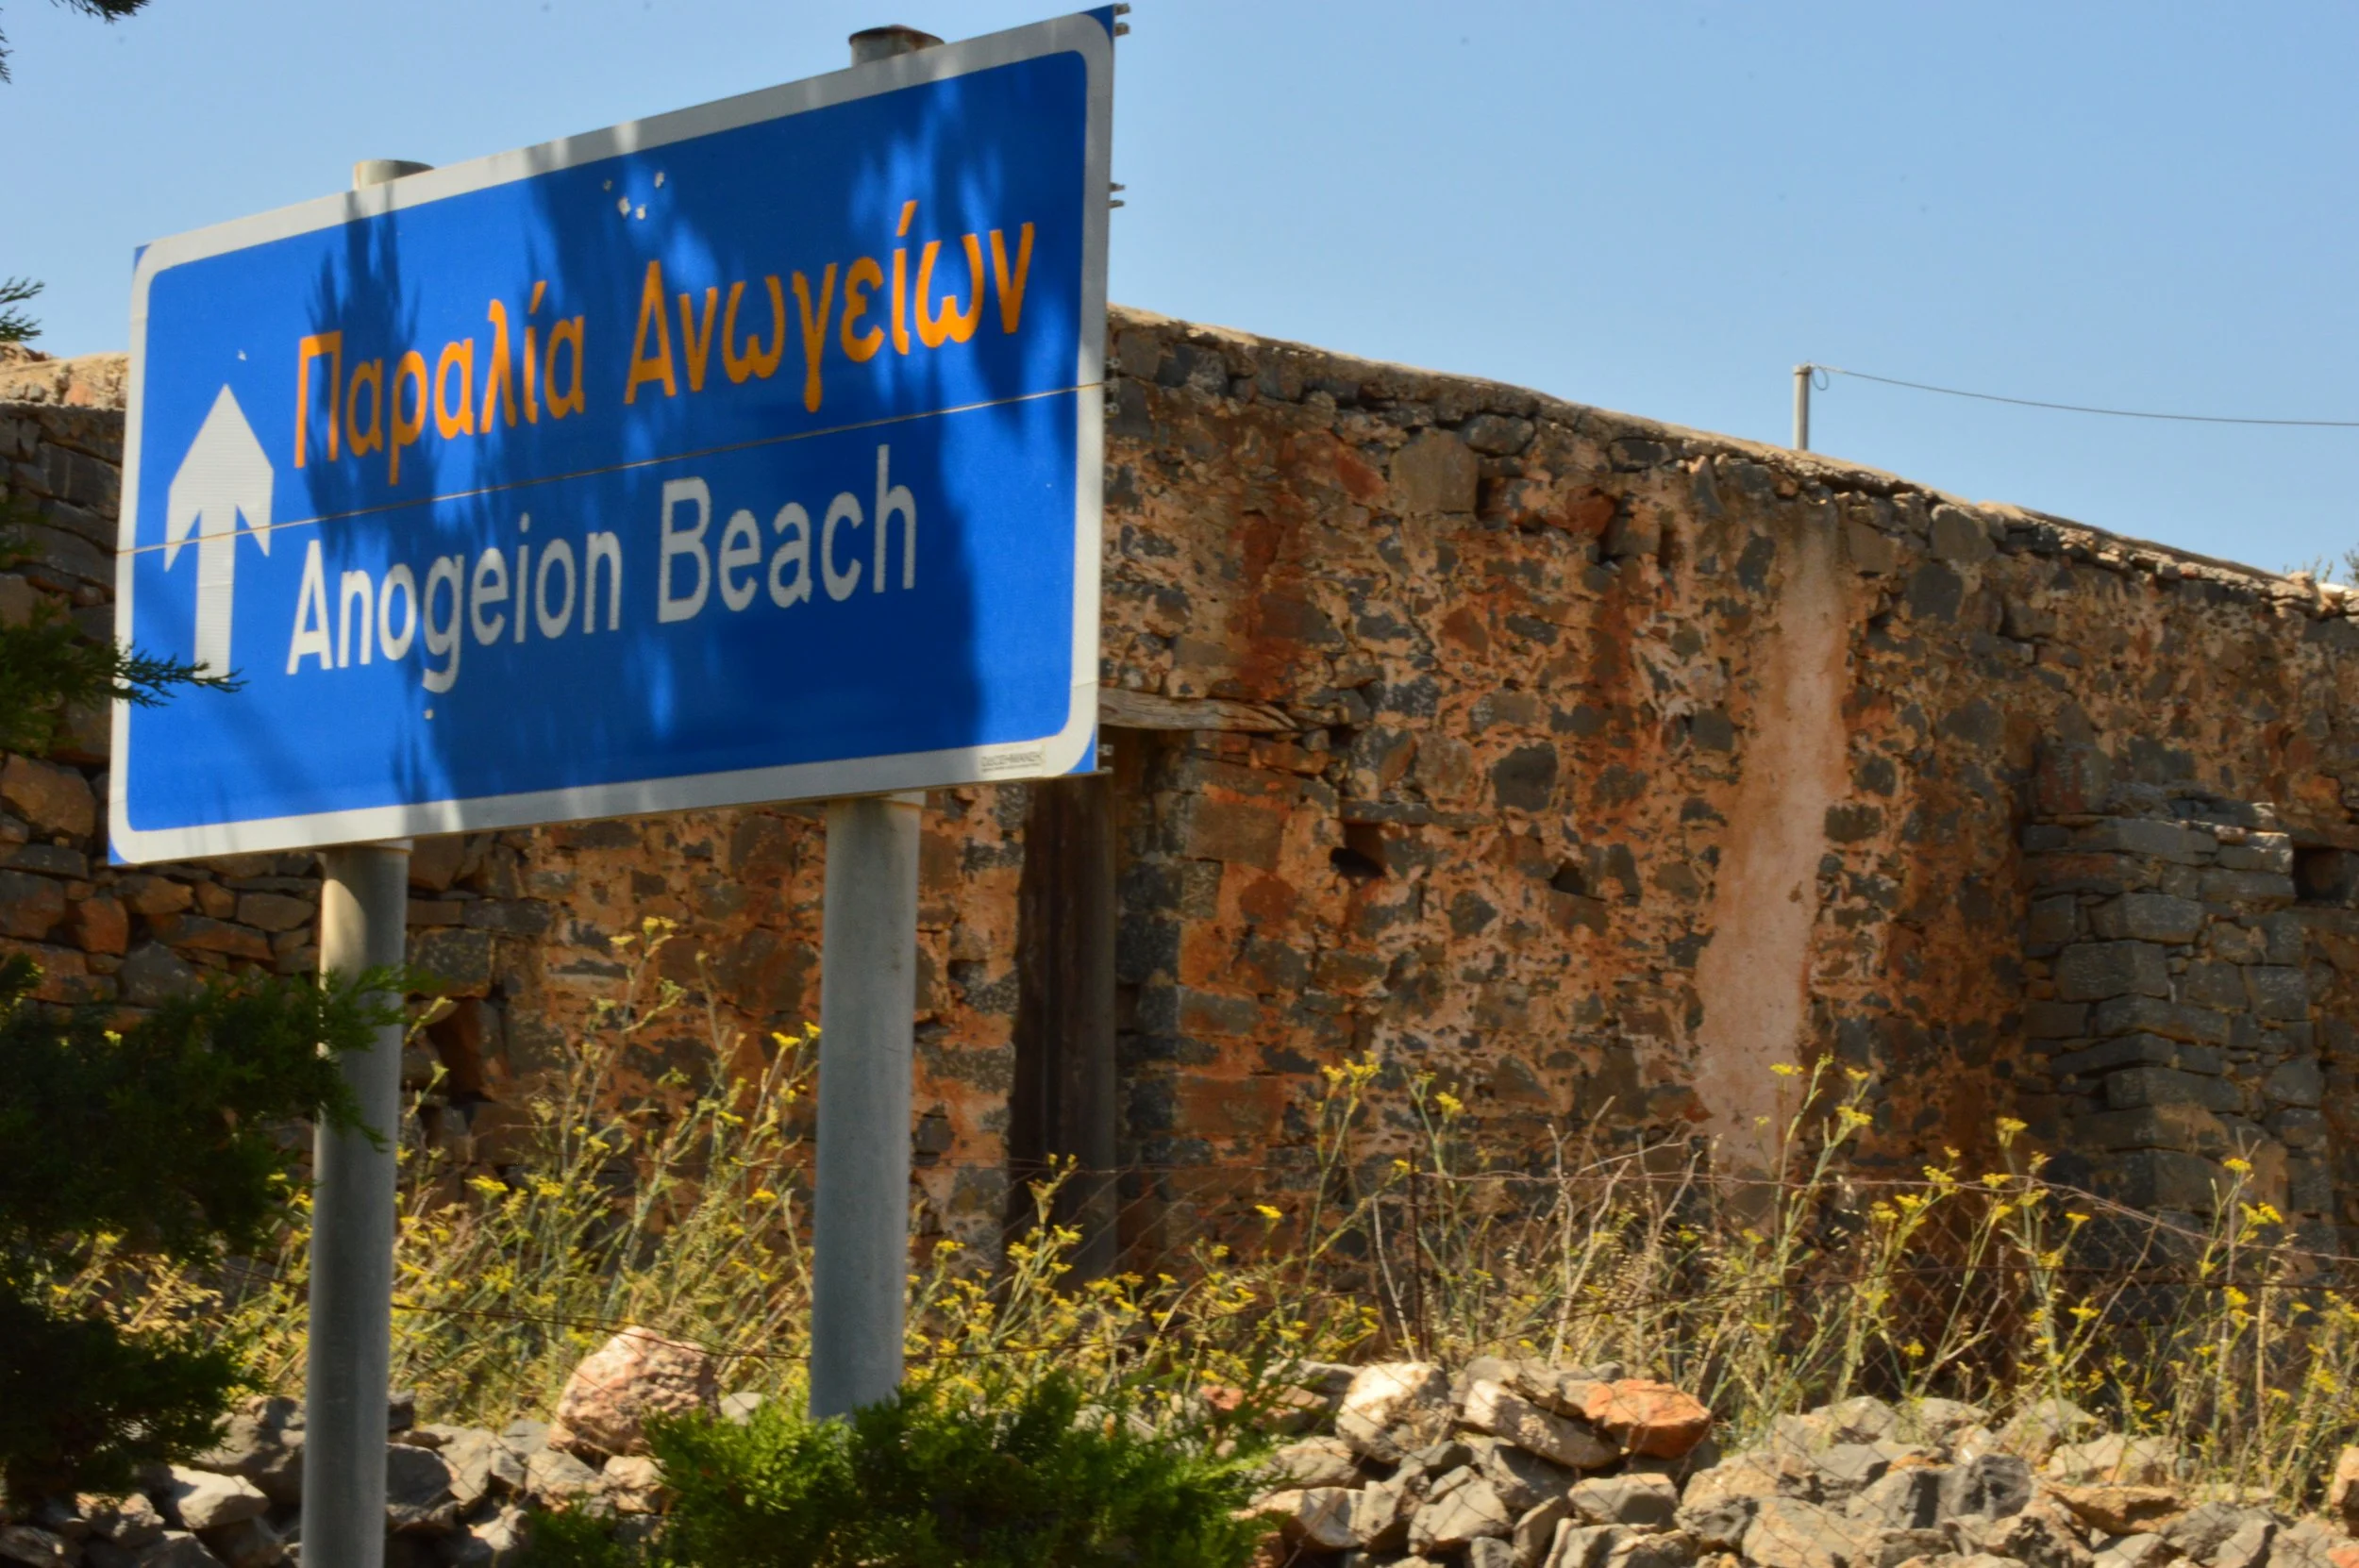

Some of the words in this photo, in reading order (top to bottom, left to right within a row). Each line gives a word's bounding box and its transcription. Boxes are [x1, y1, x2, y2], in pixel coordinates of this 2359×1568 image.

[294, 280, 585, 487] Παραλία
[625, 200, 1035, 413] Ανωγείων
[286, 512, 622, 693] Anogeion
[657, 444, 916, 624] Beach
